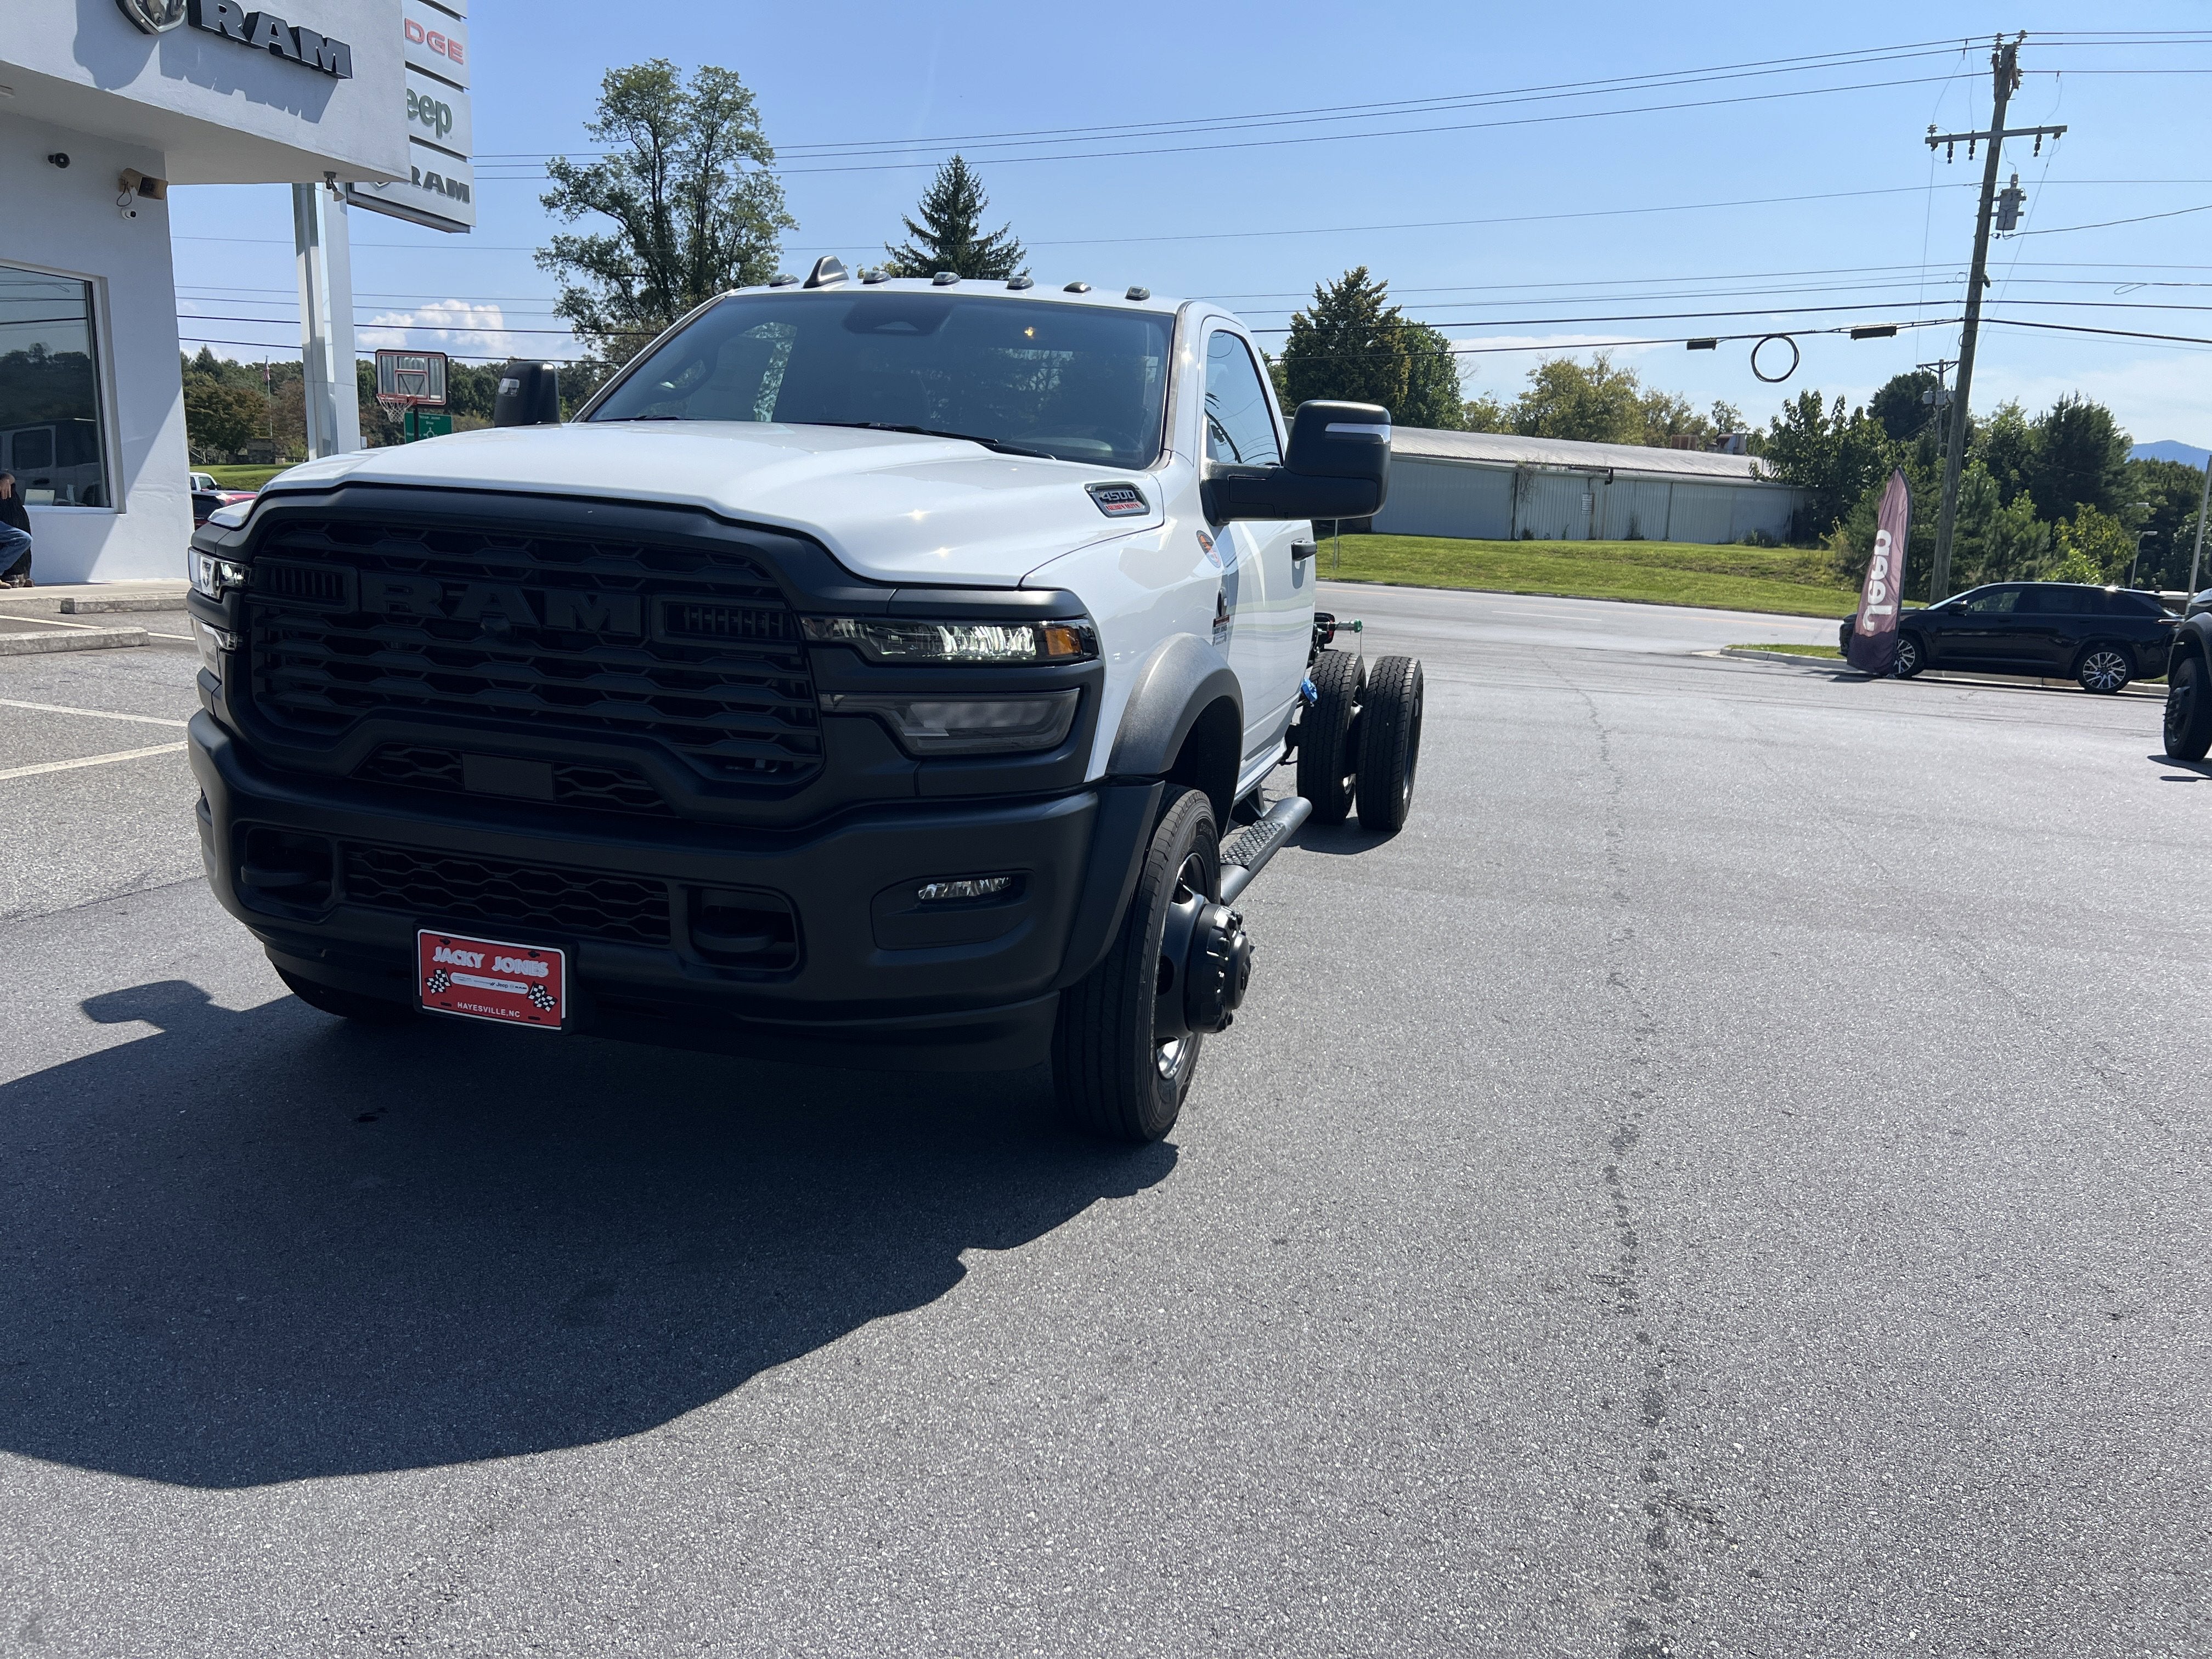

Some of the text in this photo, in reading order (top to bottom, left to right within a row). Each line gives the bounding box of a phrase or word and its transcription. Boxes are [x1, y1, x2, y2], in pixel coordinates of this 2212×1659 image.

[188, 0, 353, 79] RAM
[404, 18, 464, 65] DGE
[407, 88, 453, 139] eep
[1101, 489, 1136, 501] 4500
[359, 570, 642, 636] RAM
[432, 946, 549, 978] JACKY JONES
[457, 1002, 521, 1018] HAYESVILLE,NC
